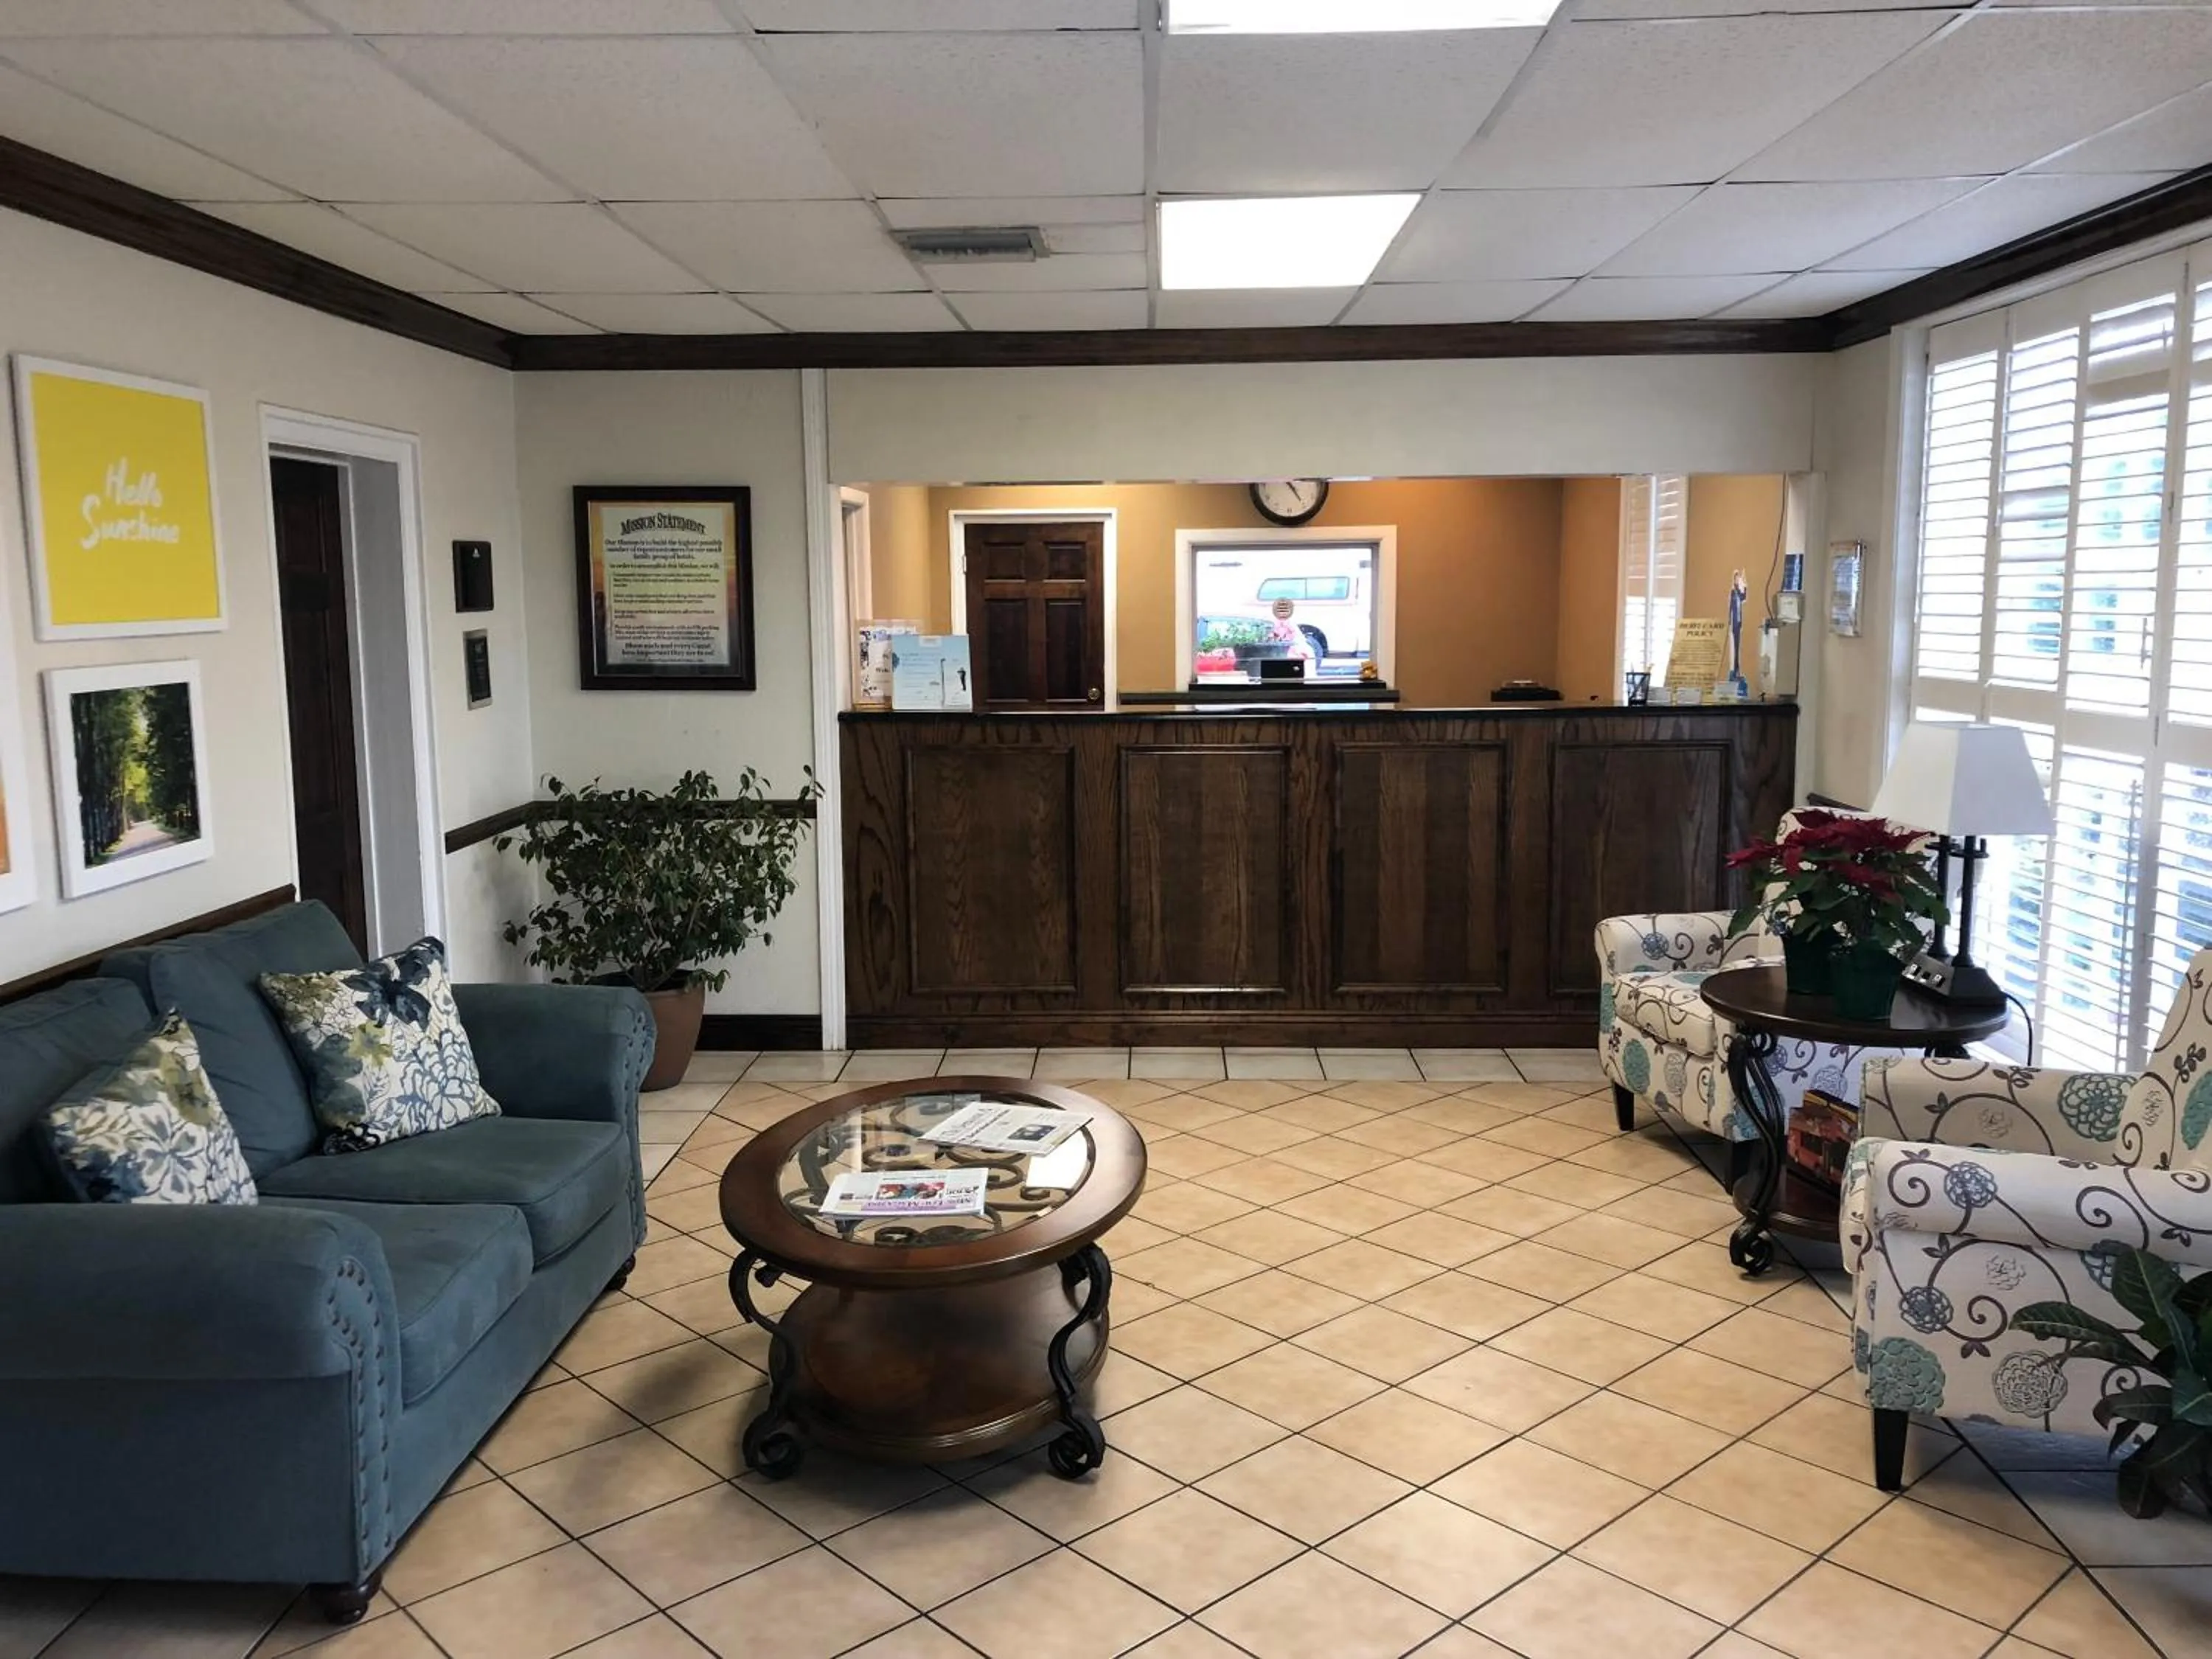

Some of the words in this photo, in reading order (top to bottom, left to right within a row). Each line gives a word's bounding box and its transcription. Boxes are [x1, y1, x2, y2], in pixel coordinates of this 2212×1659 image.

[105, 456, 163, 507] Hello
[80, 494, 179, 549] Sunshine
[621, 516, 655, 535] MISSION
[657, 512, 706, 535] STATEMENT
